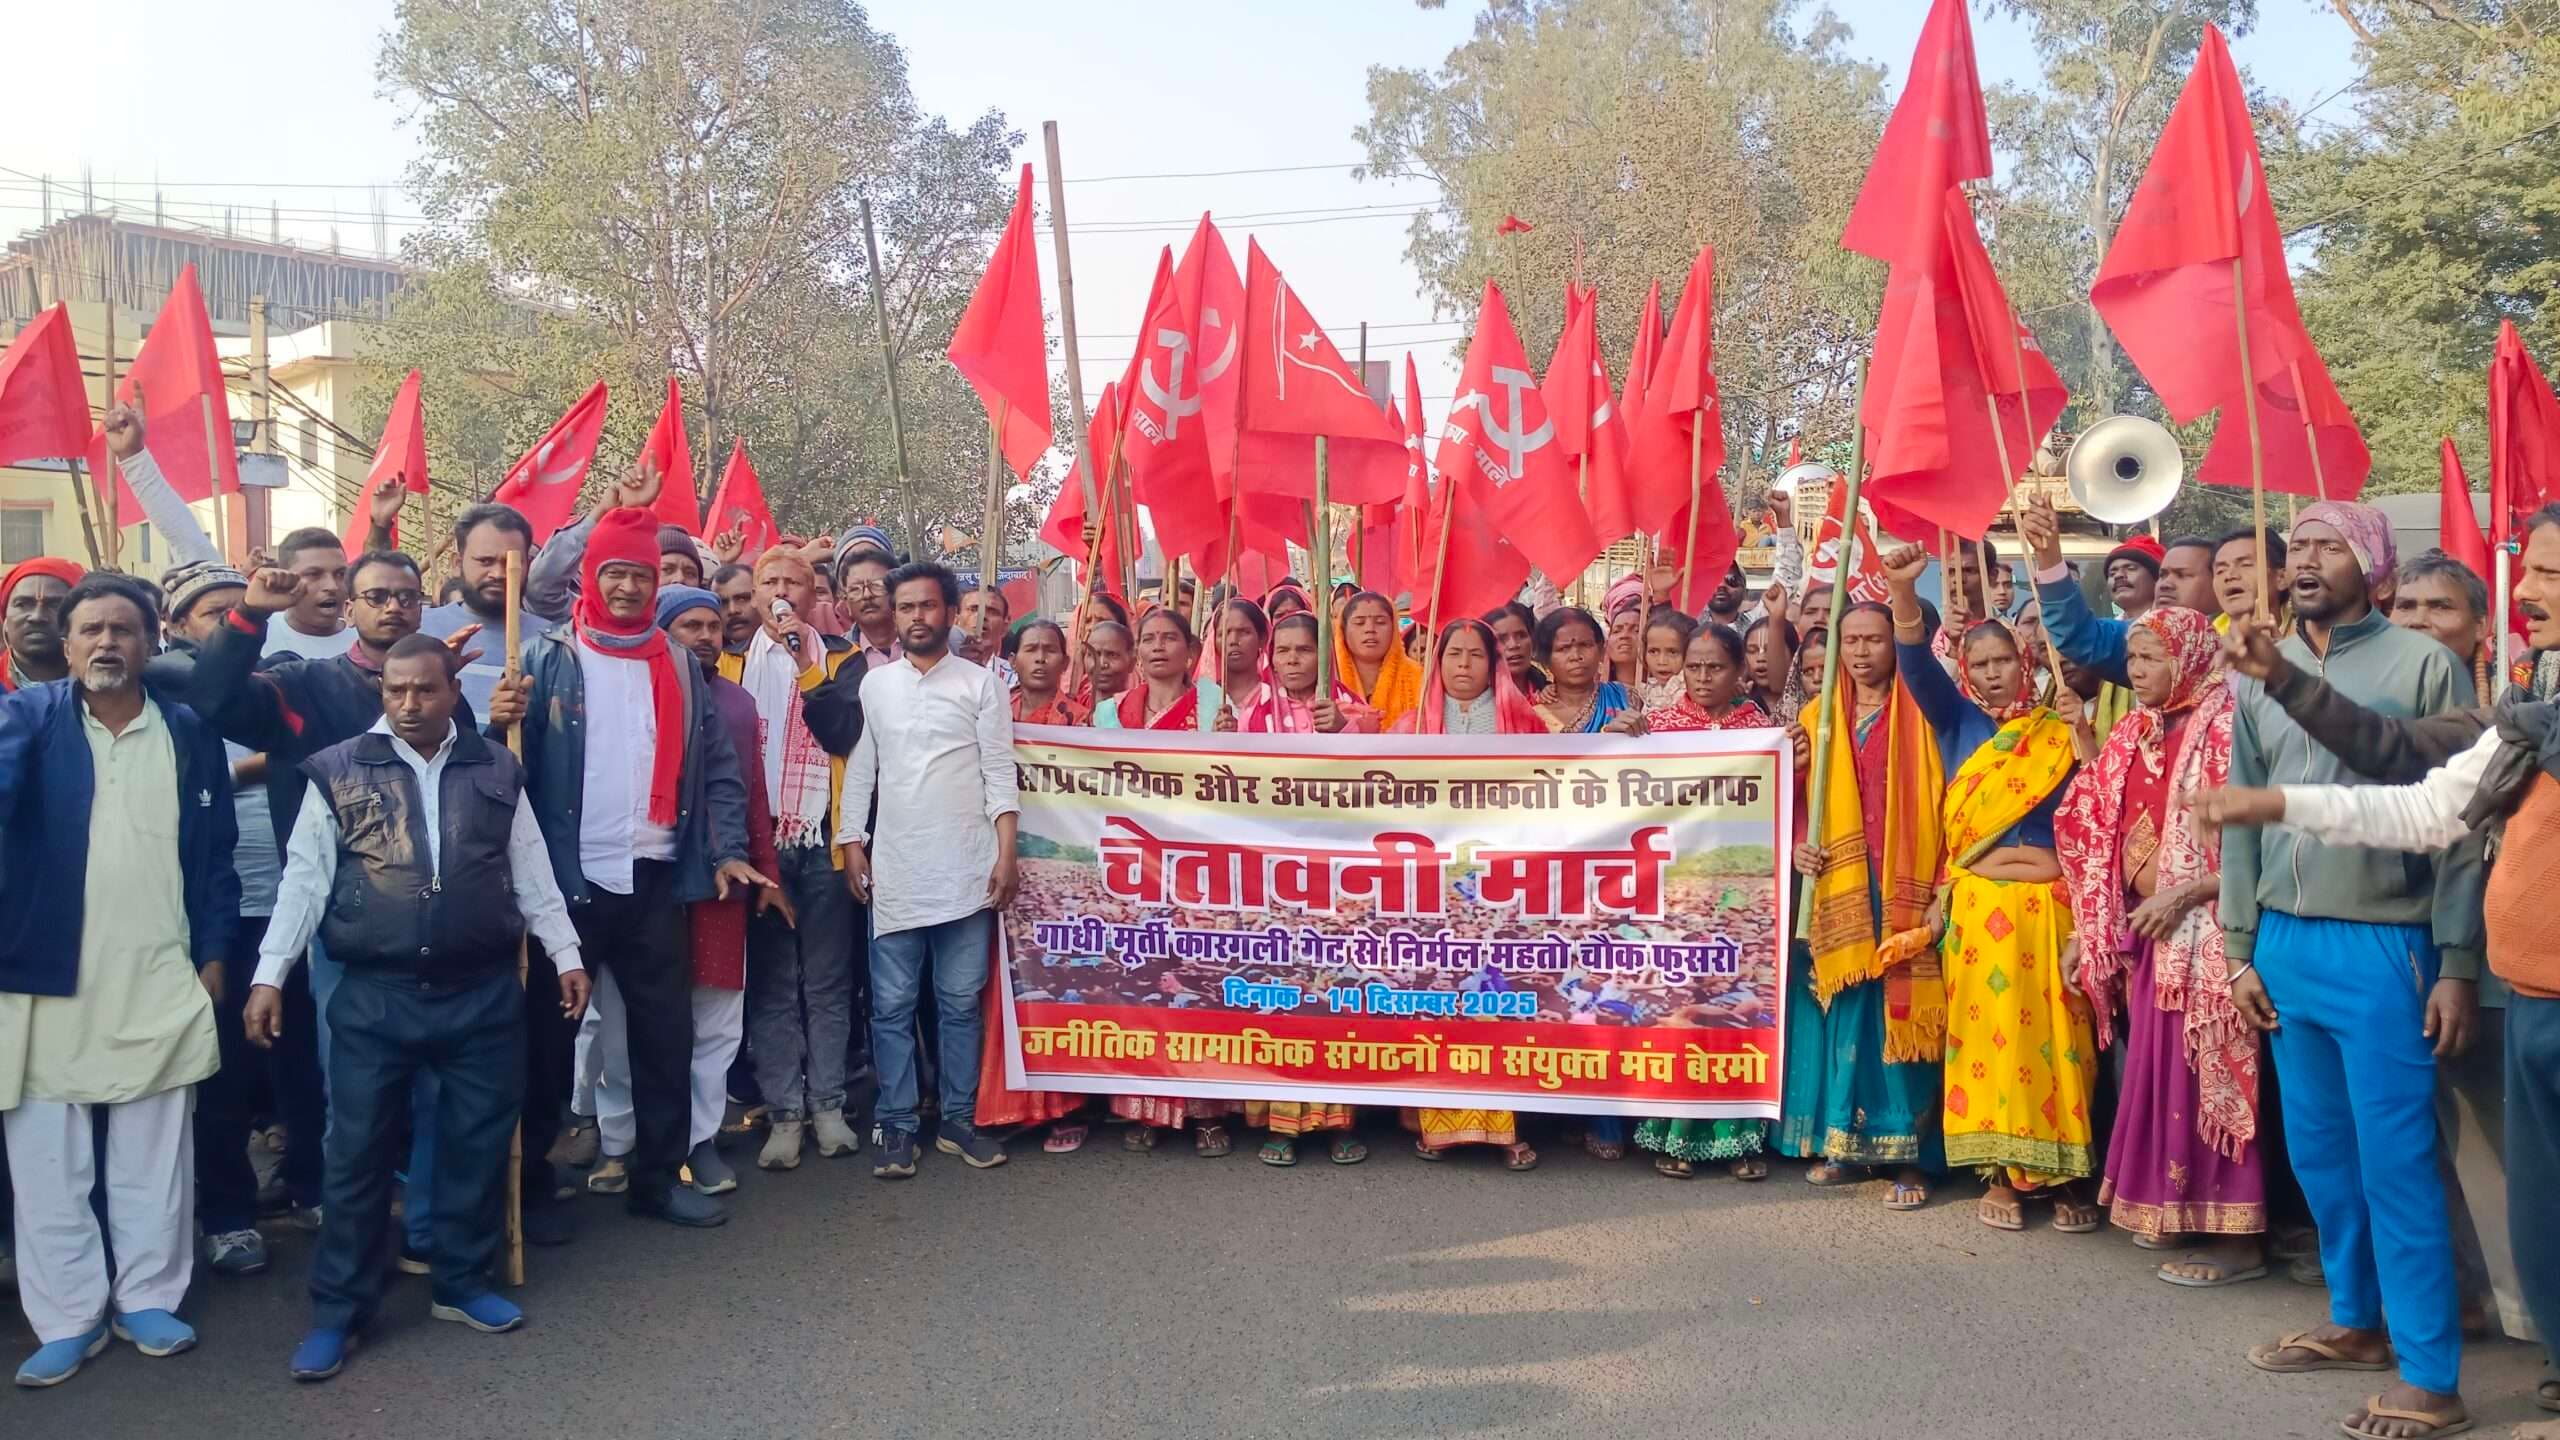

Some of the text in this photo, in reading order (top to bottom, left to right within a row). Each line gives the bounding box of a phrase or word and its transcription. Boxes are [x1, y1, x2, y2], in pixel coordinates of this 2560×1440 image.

[1195, 765, 1261, 805] और
[1272, 769, 1439, 809] अपराधिक
[1448, 768, 1562, 809] ताकतों
[1570, 768, 1609, 808] के
[1617, 768, 1762, 808] खिलाफ
[1100, 815, 1671, 916] चेतावनी मार्च
[1036, 915, 1106, 951] गांधी
[1174, 927, 1293, 963] कारगली
[1300, 929, 1346, 965] गेट
[1353, 928, 1382, 965] से
[1390, 932, 1482, 969] निर्मल
[1490, 934, 1571, 970] महतो
[1580, 934, 1646, 971] चौक
[1653, 937, 1738, 982] फुसरो
[1223, 976, 1300, 1009] दिनांक
[1328, 986, 1361, 1012] 14
[1367, 984, 1458, 1015] दिसम्बर
[1462, 992, 1537, 1016] 2025
[1018, 1019, 1769, 1090] जनीतिक सामाजिक संगठनों का संयुक्त मंच बेरमो
